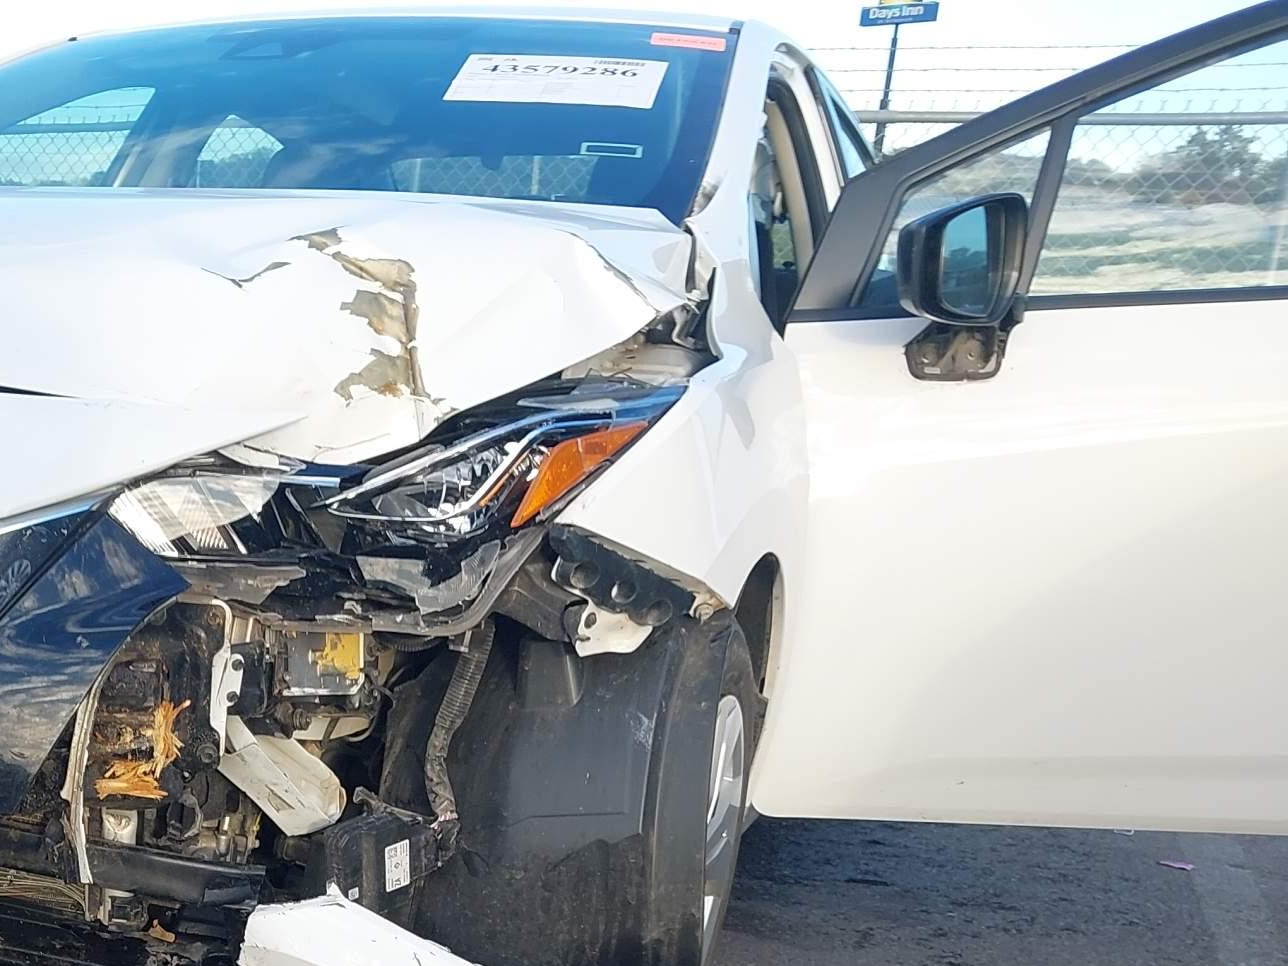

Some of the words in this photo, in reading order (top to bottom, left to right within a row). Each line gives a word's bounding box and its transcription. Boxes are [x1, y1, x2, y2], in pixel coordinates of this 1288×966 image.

[869, 7, 900, 19] Days
[902, 5, 924, 17] Inn
[482, 64, 638, 78] 43579286
